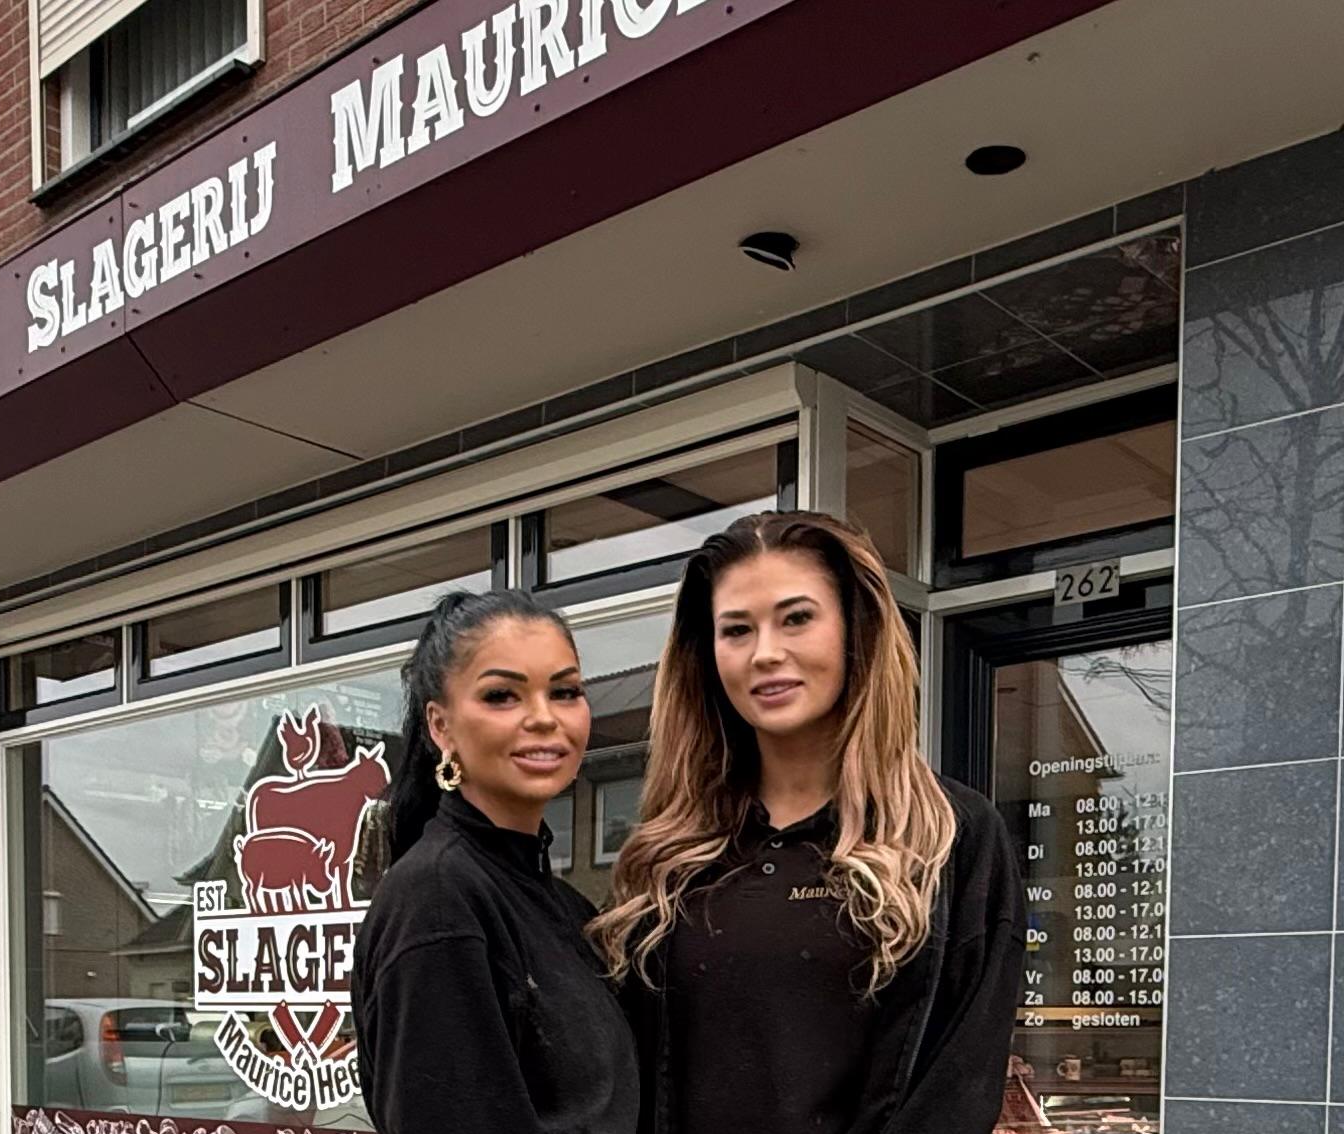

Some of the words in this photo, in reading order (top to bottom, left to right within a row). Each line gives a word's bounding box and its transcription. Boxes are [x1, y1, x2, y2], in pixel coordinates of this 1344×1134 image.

[27, 141, 276, 353] SLAGERIJ
[330, 0, 712, 193] MAURI
[1060, 565, 1113, 602] 262
[1028, 803, 1051, 818] Ma
[1076, 796, 1117, 814] 08.00
[1135, 791, 1166, 808] 12.1
[1076, 818, 1117, 835] 13.00
[1133, 813, 1167, 830] 17.0
[1027, 844, 1044, 860] Di
[1075, 839, 1117, 856] 08.00
[1132, 836, 1164, 852] 12.1
[1076, 861, 1117, 877] 13.00
[1131, 858, 1167, 874] 17.0
[197, 885, 224, 912] EST
[1026, 886, 1052, 902] Wo
[1074, 882, 1116, 899] 08.00
[1131, 880, 1165, 896] 12.1
[1074, 904, 1116, 920] 13.00
[1130, 902, 1166, 918] 17.0
[1026, 928, 1048, 943] Do
[1073, 926, 1116, 942] 08.00
[1130, 924, 1164, 939] 12.1
[198, 922, 360, 994] SLAGE
[1073, 947, 1115, 963] 13.00
[1129, 946, 1165, 961] 17.0
[1025, 970, 1043, 984] Vr
[1072, 969, 1115, 984] 08.00
[1129, 968, 1164, 983] 17.0
[1024, 991, 1044, 1005] Za
[1072, 990, 1114, 1005] 08.00
[1128, 990, 1164, 1005] 15.0
[1024, 1012, 1044, 1026] Zo
[1072, 1011, 1140, 1030] gesloten
[218, 1014, 307, 1105] Maurice
